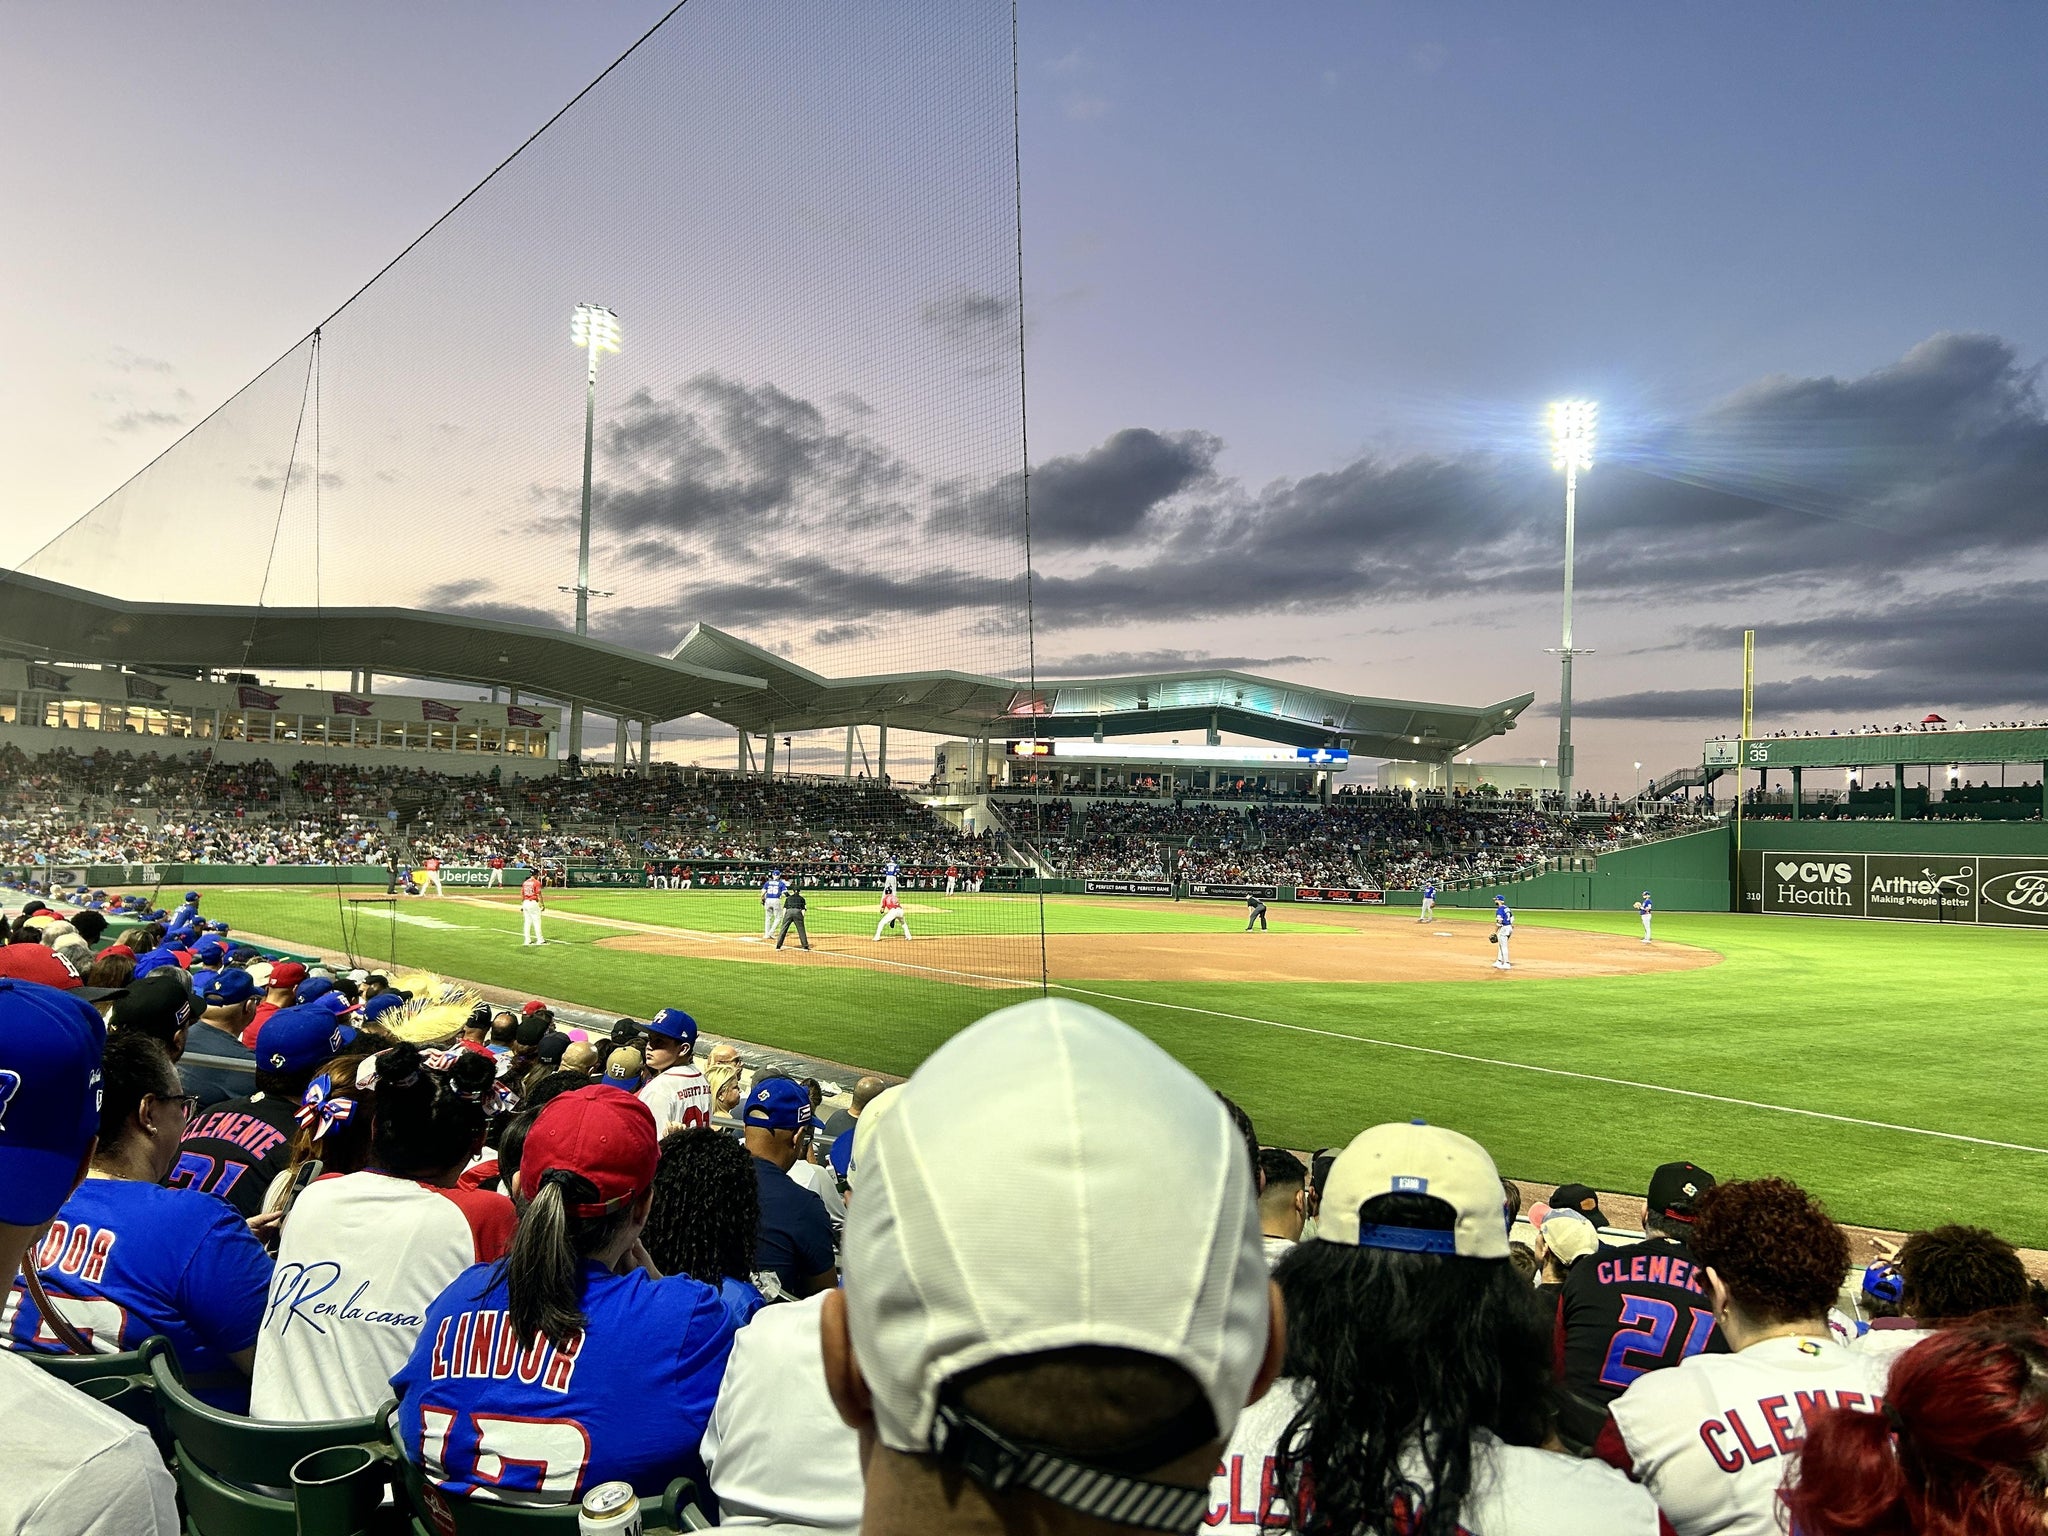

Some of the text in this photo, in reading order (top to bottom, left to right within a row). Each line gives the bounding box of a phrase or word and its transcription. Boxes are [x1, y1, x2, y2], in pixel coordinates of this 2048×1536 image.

[1750, 750, 1767, 761] 39
[1799, 862, 1852, 884] CVS
[1870, 868, 1944, 895] Arthrex
[1746, 892, 1761, 901] 310
[1777, 884, 1852, 906] Health
[1871, 894, 1969, 907] Making People Better
[611, 1062, 626, 1077] PR
[180, 1111, 287, 1161] CLEMENTE
[36, 1220, 116, 1284] DOR
[264, 1261, 423, 1336] PR en la casa
[430, 1310, 586, 1395] LINDOR
[1599, 1293, 1717, 1388] 21
